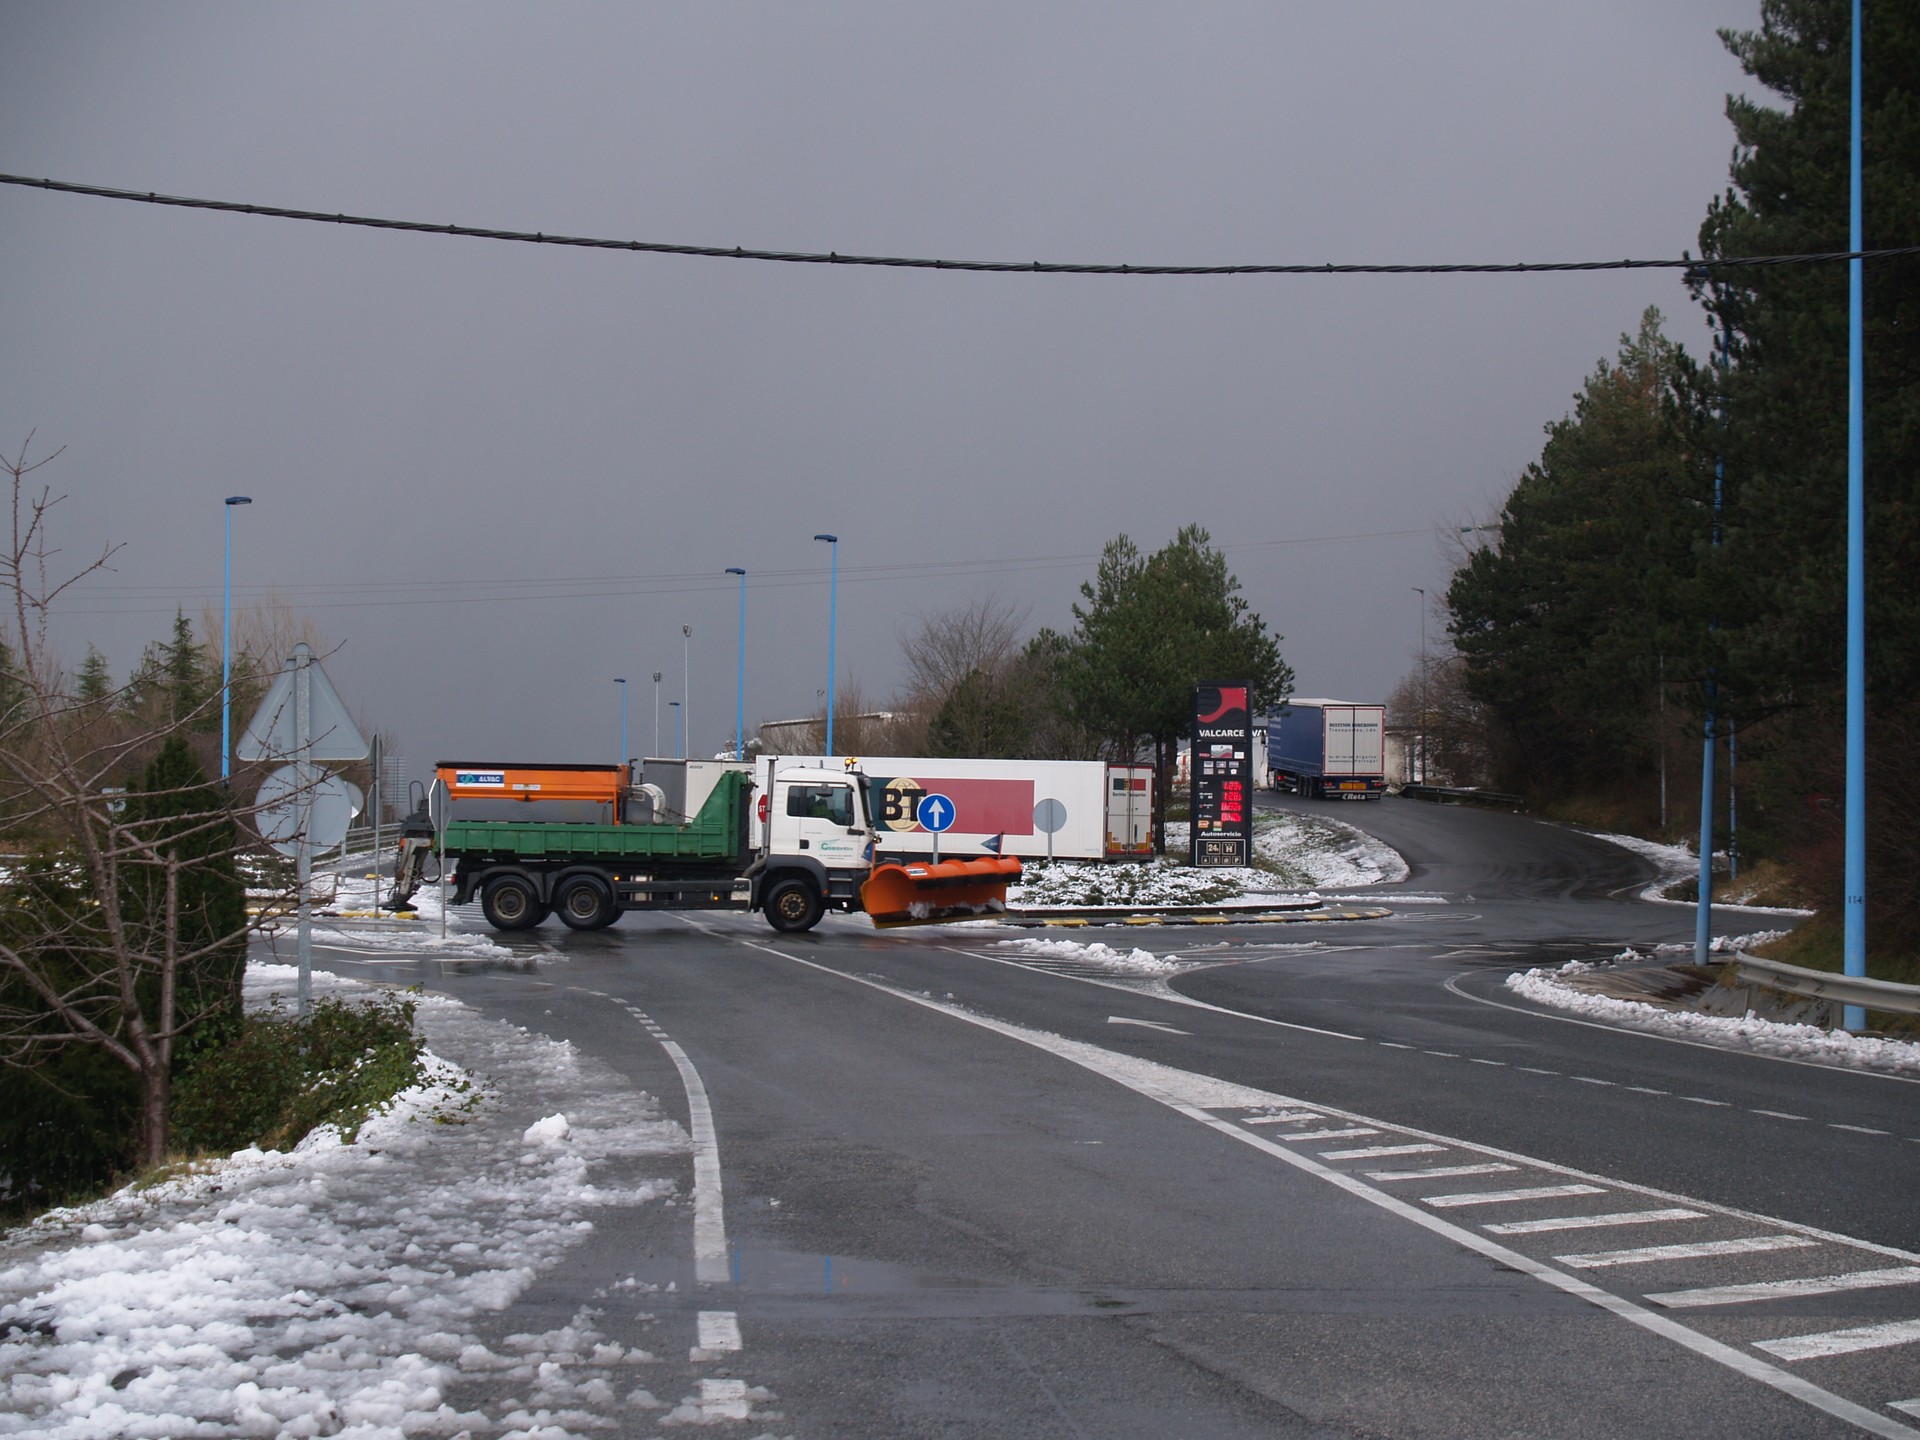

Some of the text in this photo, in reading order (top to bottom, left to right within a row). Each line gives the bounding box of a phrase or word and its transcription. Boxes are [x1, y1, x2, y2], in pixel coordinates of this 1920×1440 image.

[1199, 729, 1245, 737] VALCARCE
[879, 787, 928, 822] BT
[1848, 895, 1863, 904] 114
